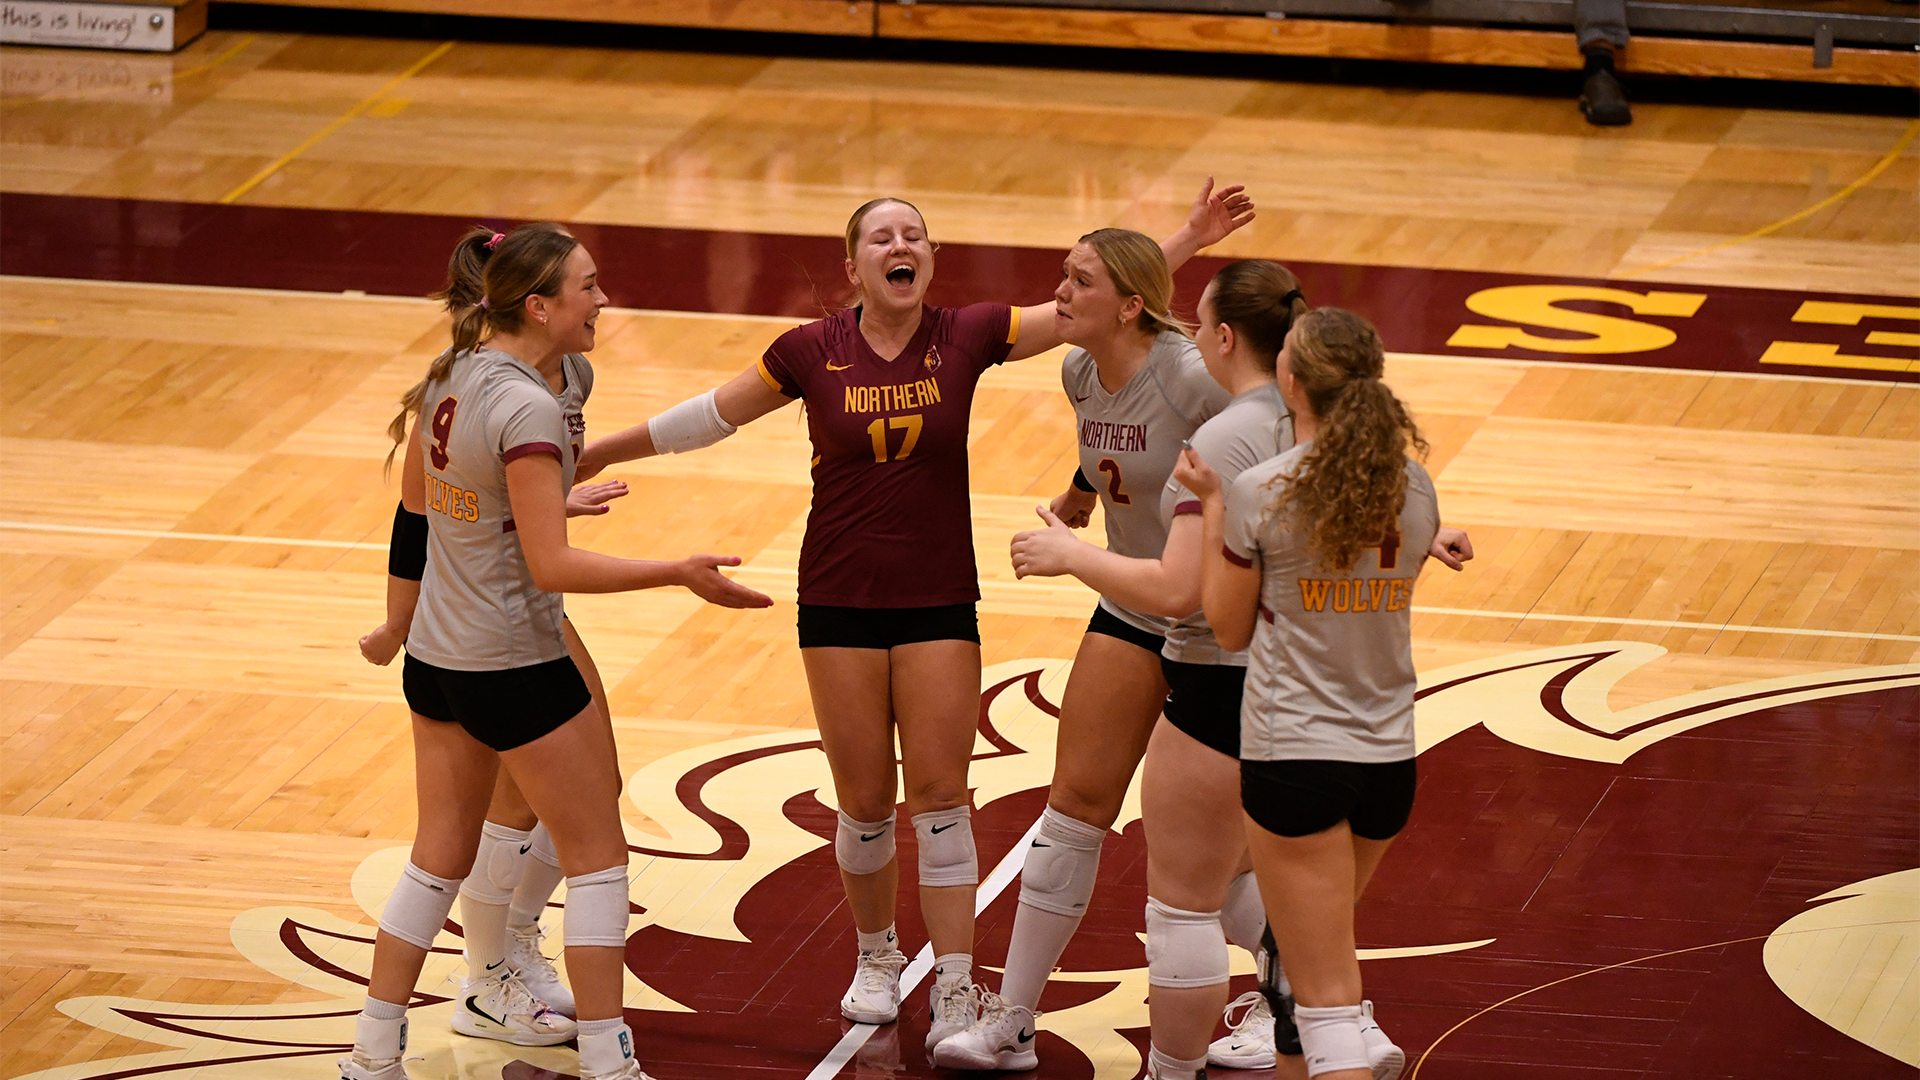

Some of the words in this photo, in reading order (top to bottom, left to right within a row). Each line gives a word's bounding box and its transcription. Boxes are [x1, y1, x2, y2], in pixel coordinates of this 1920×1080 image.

[1, 5, 42, 28] this
[50, 13, 68, 29] is
[844, 377, 941, 413] NORTHERN
[430, 395, 458, 472] 9
[867, 413, 923, 463] 17
[1080, 418, 1147, 452] NORTHERN
[424, 471, 480, 523] OLVES
[1098, 457, 1131, 506] 2
[1298, 577, 1413, 612] WOLVES
